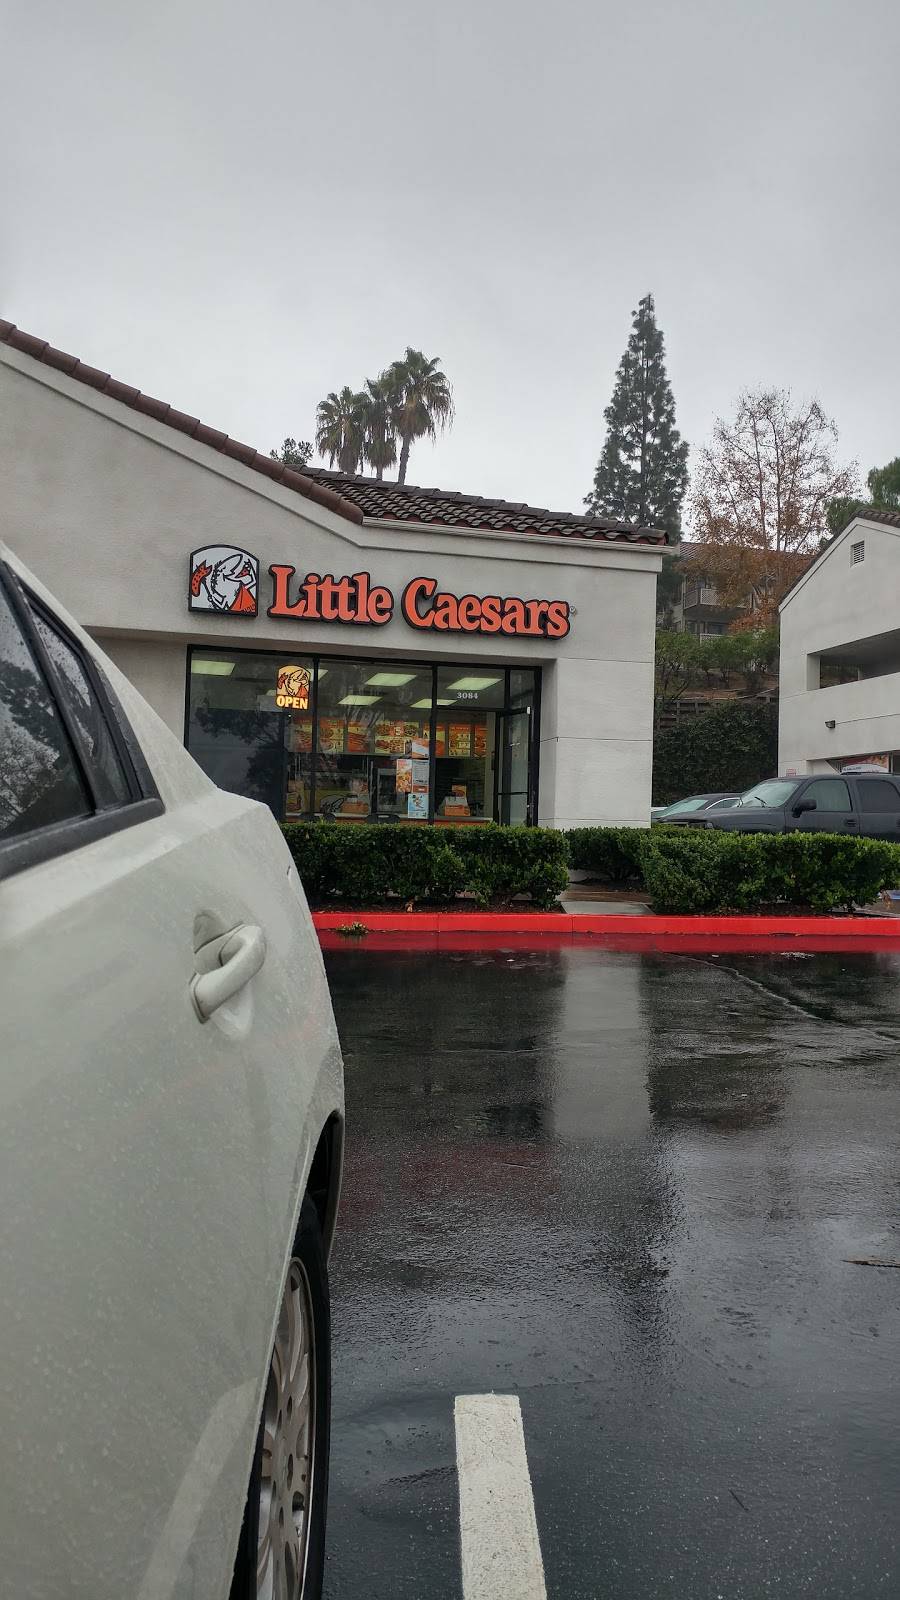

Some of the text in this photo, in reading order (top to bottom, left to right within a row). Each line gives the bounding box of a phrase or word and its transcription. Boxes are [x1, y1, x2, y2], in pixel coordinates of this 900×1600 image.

[268, 565, 571, 639] Little Caesars
[276, 695, 308, 710] OPEN
